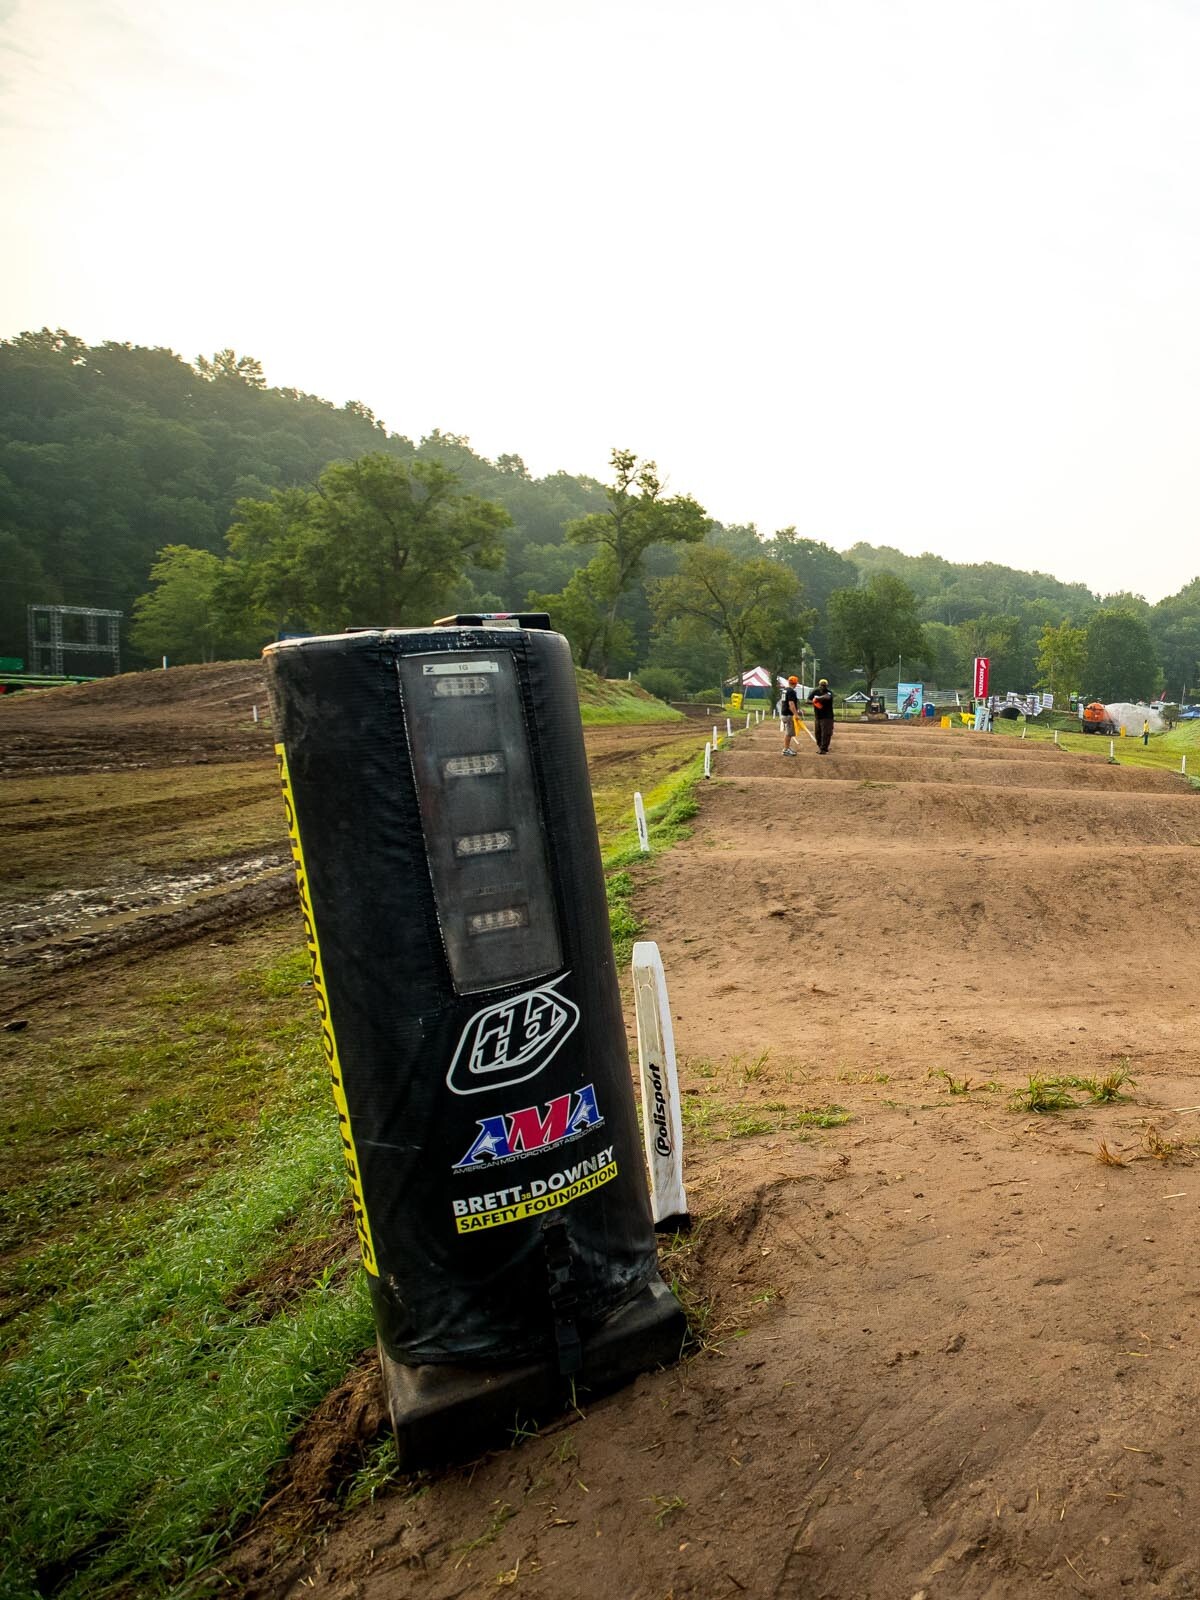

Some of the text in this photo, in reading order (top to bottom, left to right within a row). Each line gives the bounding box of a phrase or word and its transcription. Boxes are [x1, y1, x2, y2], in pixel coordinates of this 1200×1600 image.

[452, 1083, 604, 1169] AMA
[648, 1063, 671, 1157] Polisport
[452, 1185, 523, 1217] BRETT
[530, 1145, 614, 1198] DOWNEY
[453, 1120, 605, 1174] AMERICAN MOTORCYCLIST ASSOCIATION
[460, 1164, 616, 1230] SAFETY FOUNDATION
